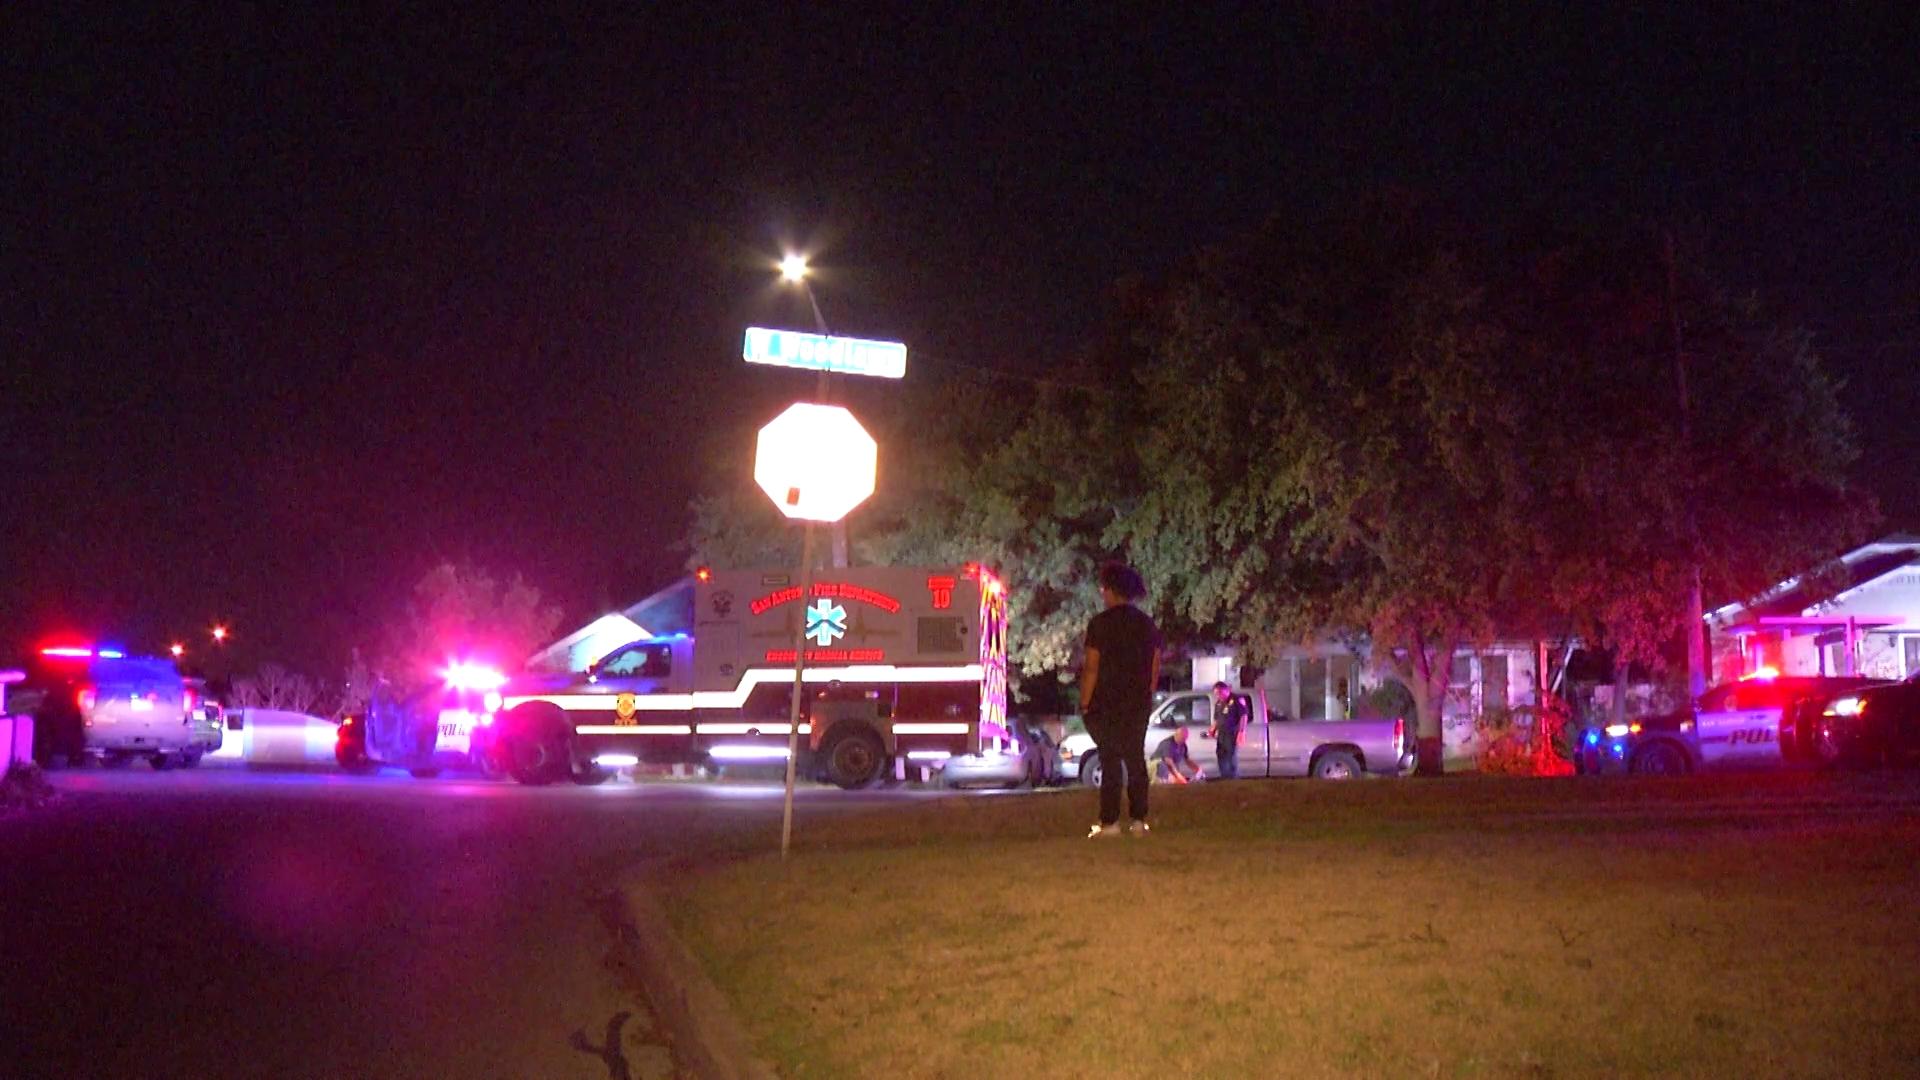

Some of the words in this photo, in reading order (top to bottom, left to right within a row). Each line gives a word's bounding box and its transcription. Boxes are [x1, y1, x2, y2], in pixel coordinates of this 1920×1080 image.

[751, 597, 771, 615] SAN
[814, 583, 837, 596] FIRE
[933, 589, 951, 608] 10
